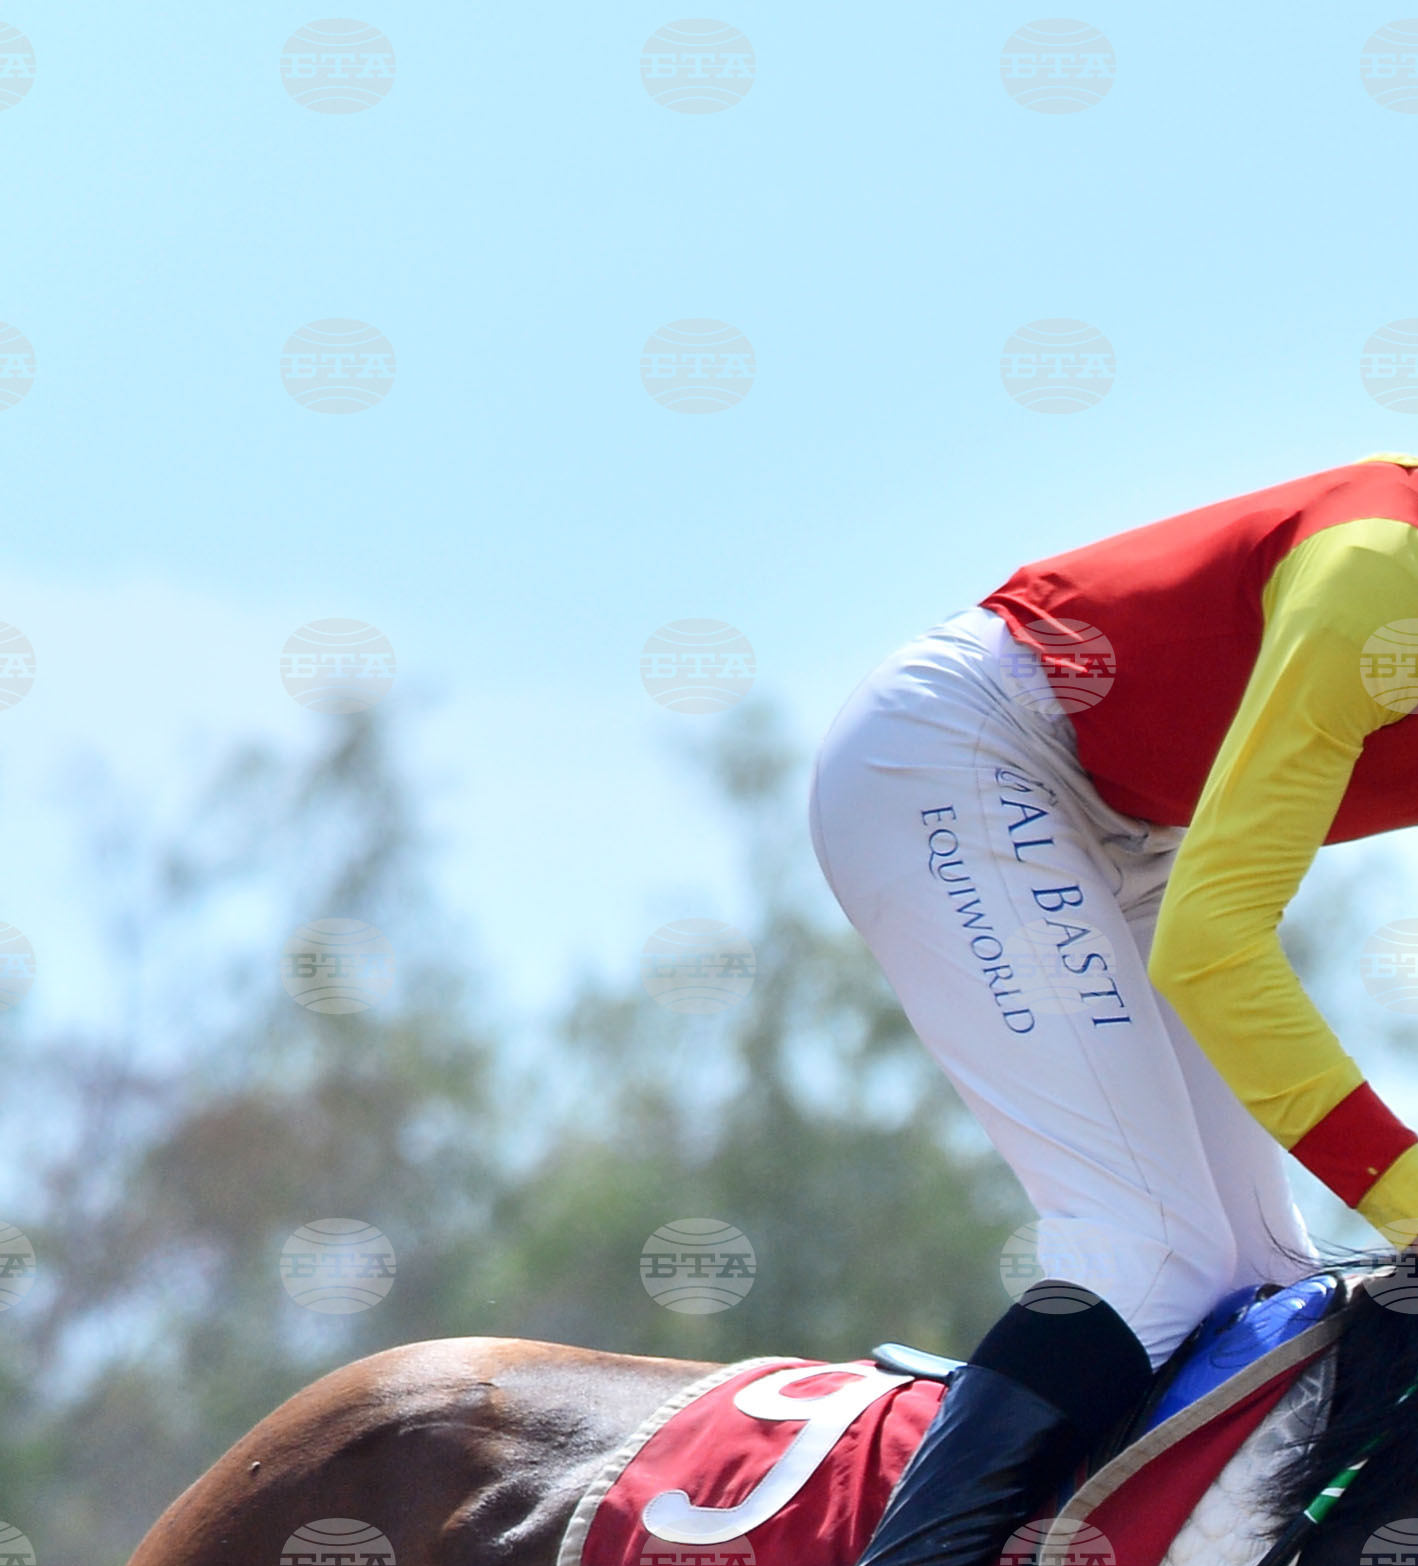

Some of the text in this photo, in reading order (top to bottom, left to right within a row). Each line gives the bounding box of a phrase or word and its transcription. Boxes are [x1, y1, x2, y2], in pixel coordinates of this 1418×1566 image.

[921, 804, 1036, 1035] EQUIWORLD
[1031, 881, 1132, 1027] BASTI
[643, 1362, 915, 1545] 9
